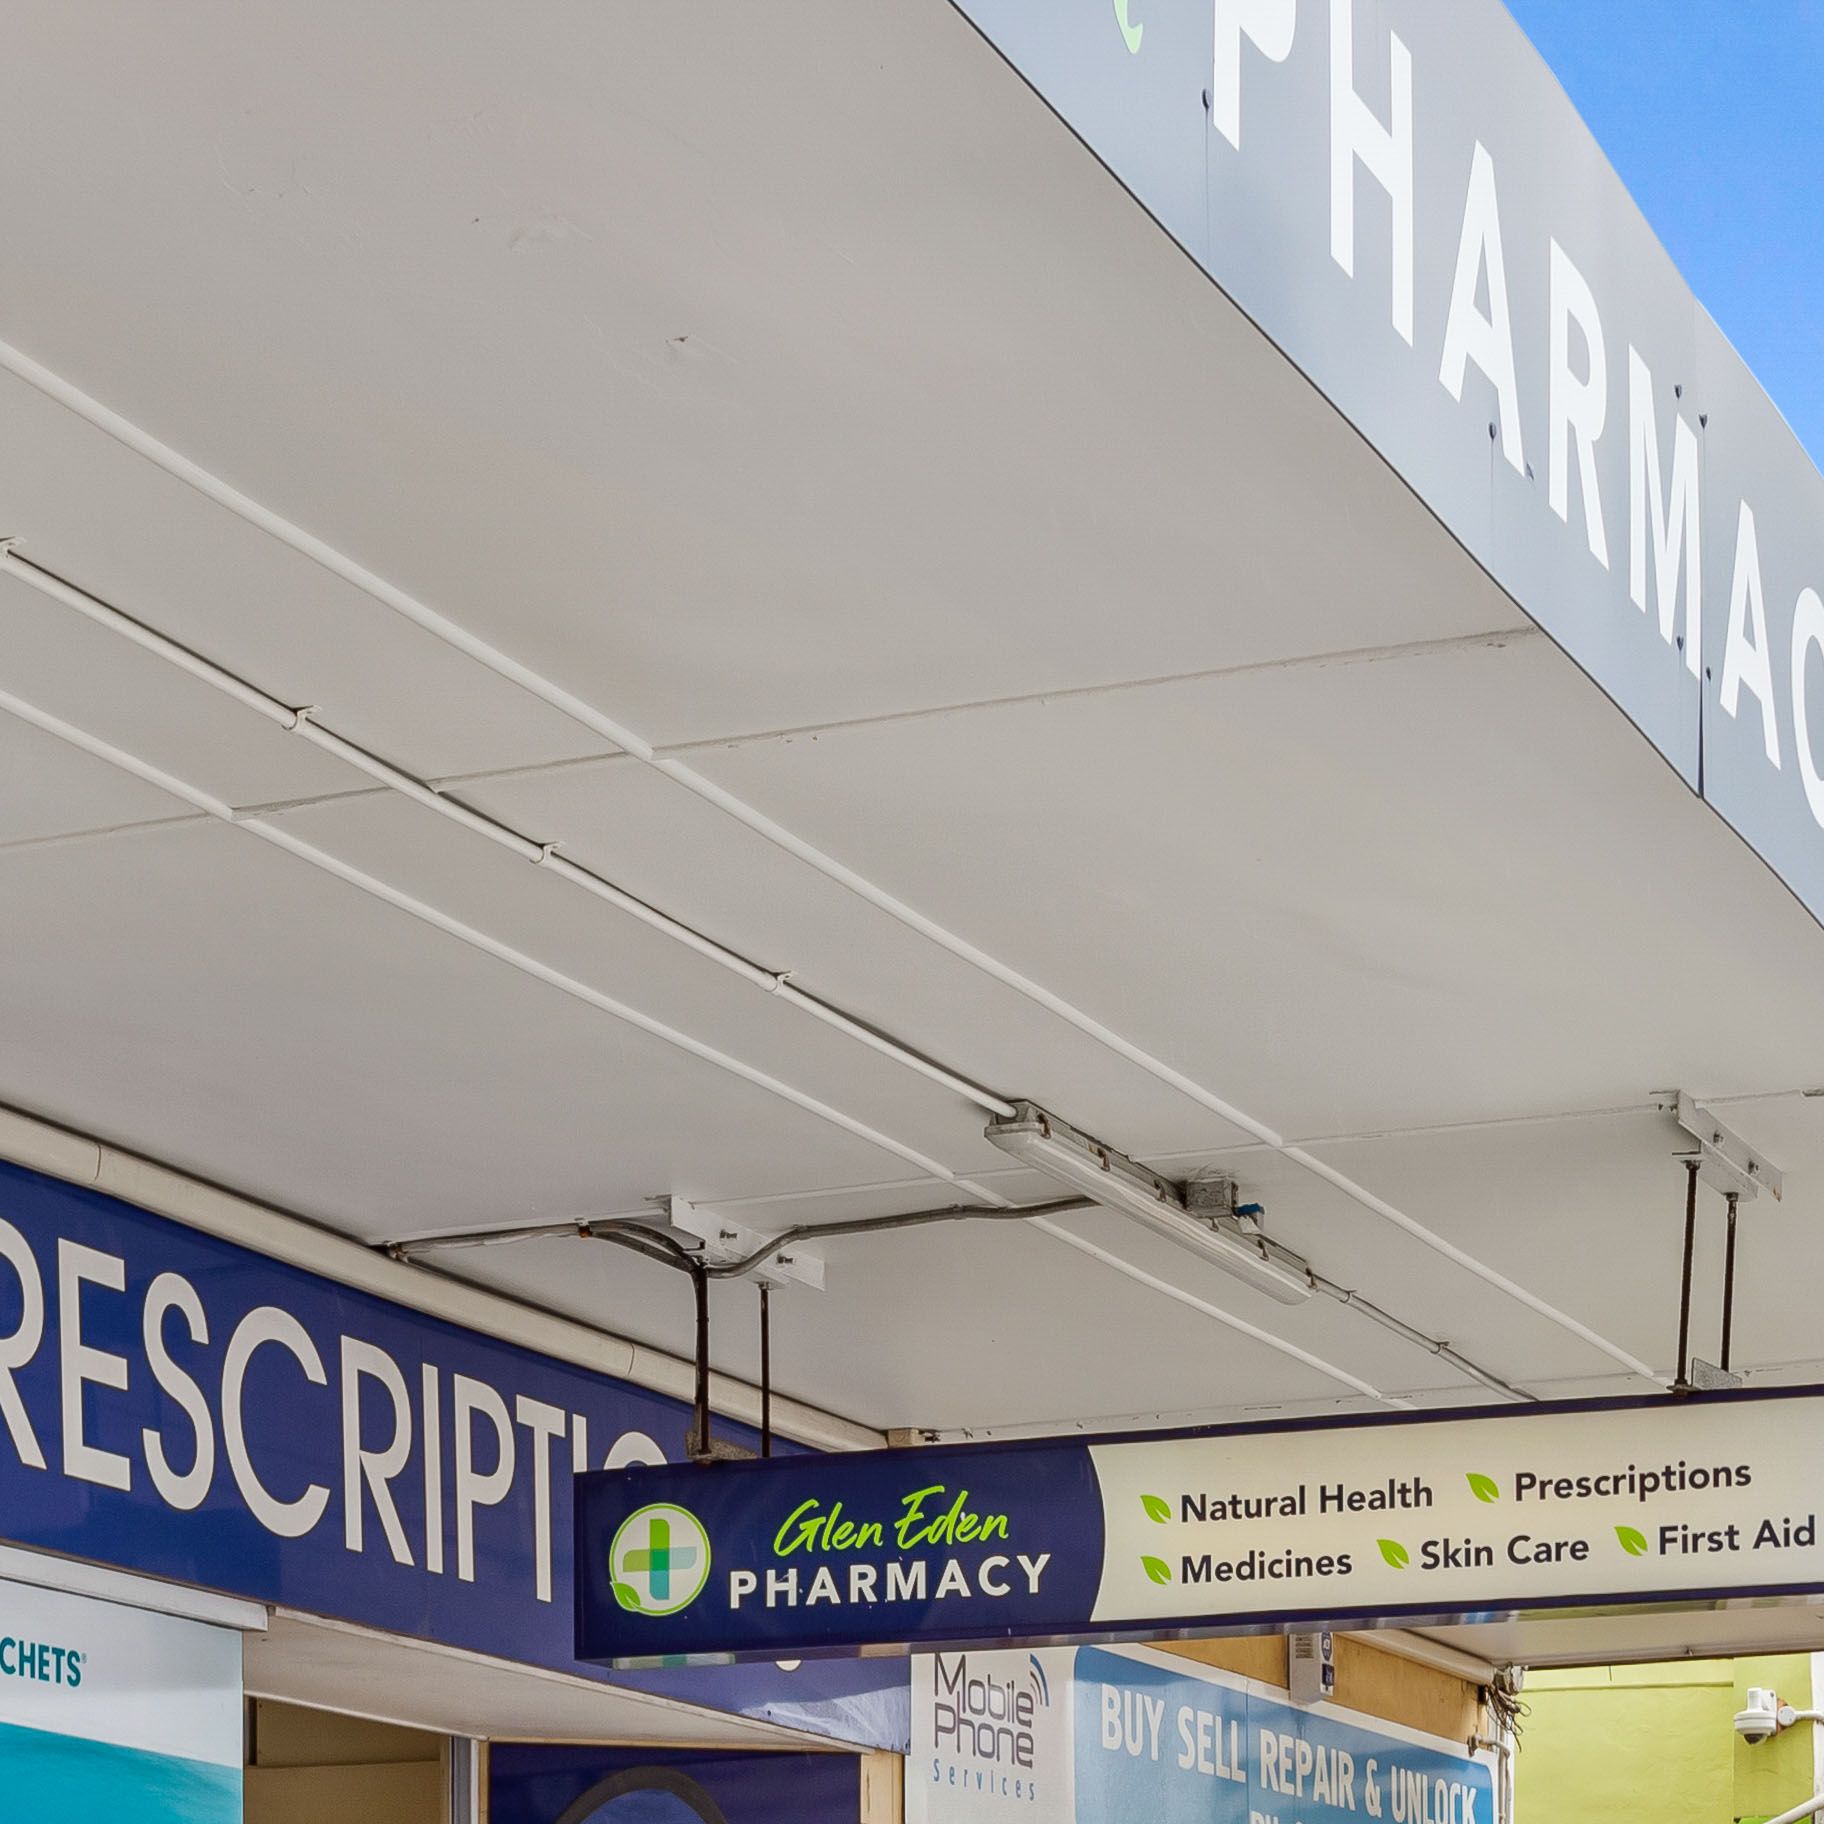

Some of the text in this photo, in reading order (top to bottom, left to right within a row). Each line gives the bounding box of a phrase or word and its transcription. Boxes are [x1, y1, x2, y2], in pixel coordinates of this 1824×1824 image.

[773, 1484, 1009, 1557] Glen Eden
[1180, 1460, 1752, 1524] Natural Health Prescriptions
[729, 1553, 1052, 1609] PHARMACY
[1180, 1514, 1816, 1585] Medicines Skin Care First Aid
[933, 1652, 1036, 1724] Mobile
[933, 1704, 1036, 1769] Phone
[1100, 1682, 1166, 1763] BUY
[1177, 1705, 1247, 1785] SELL
[1259, 1728, 1356, 1811] REPAIR
[1364, 1760, 1382, 1817] &
[932, 1757, 1036, 1802] Services
